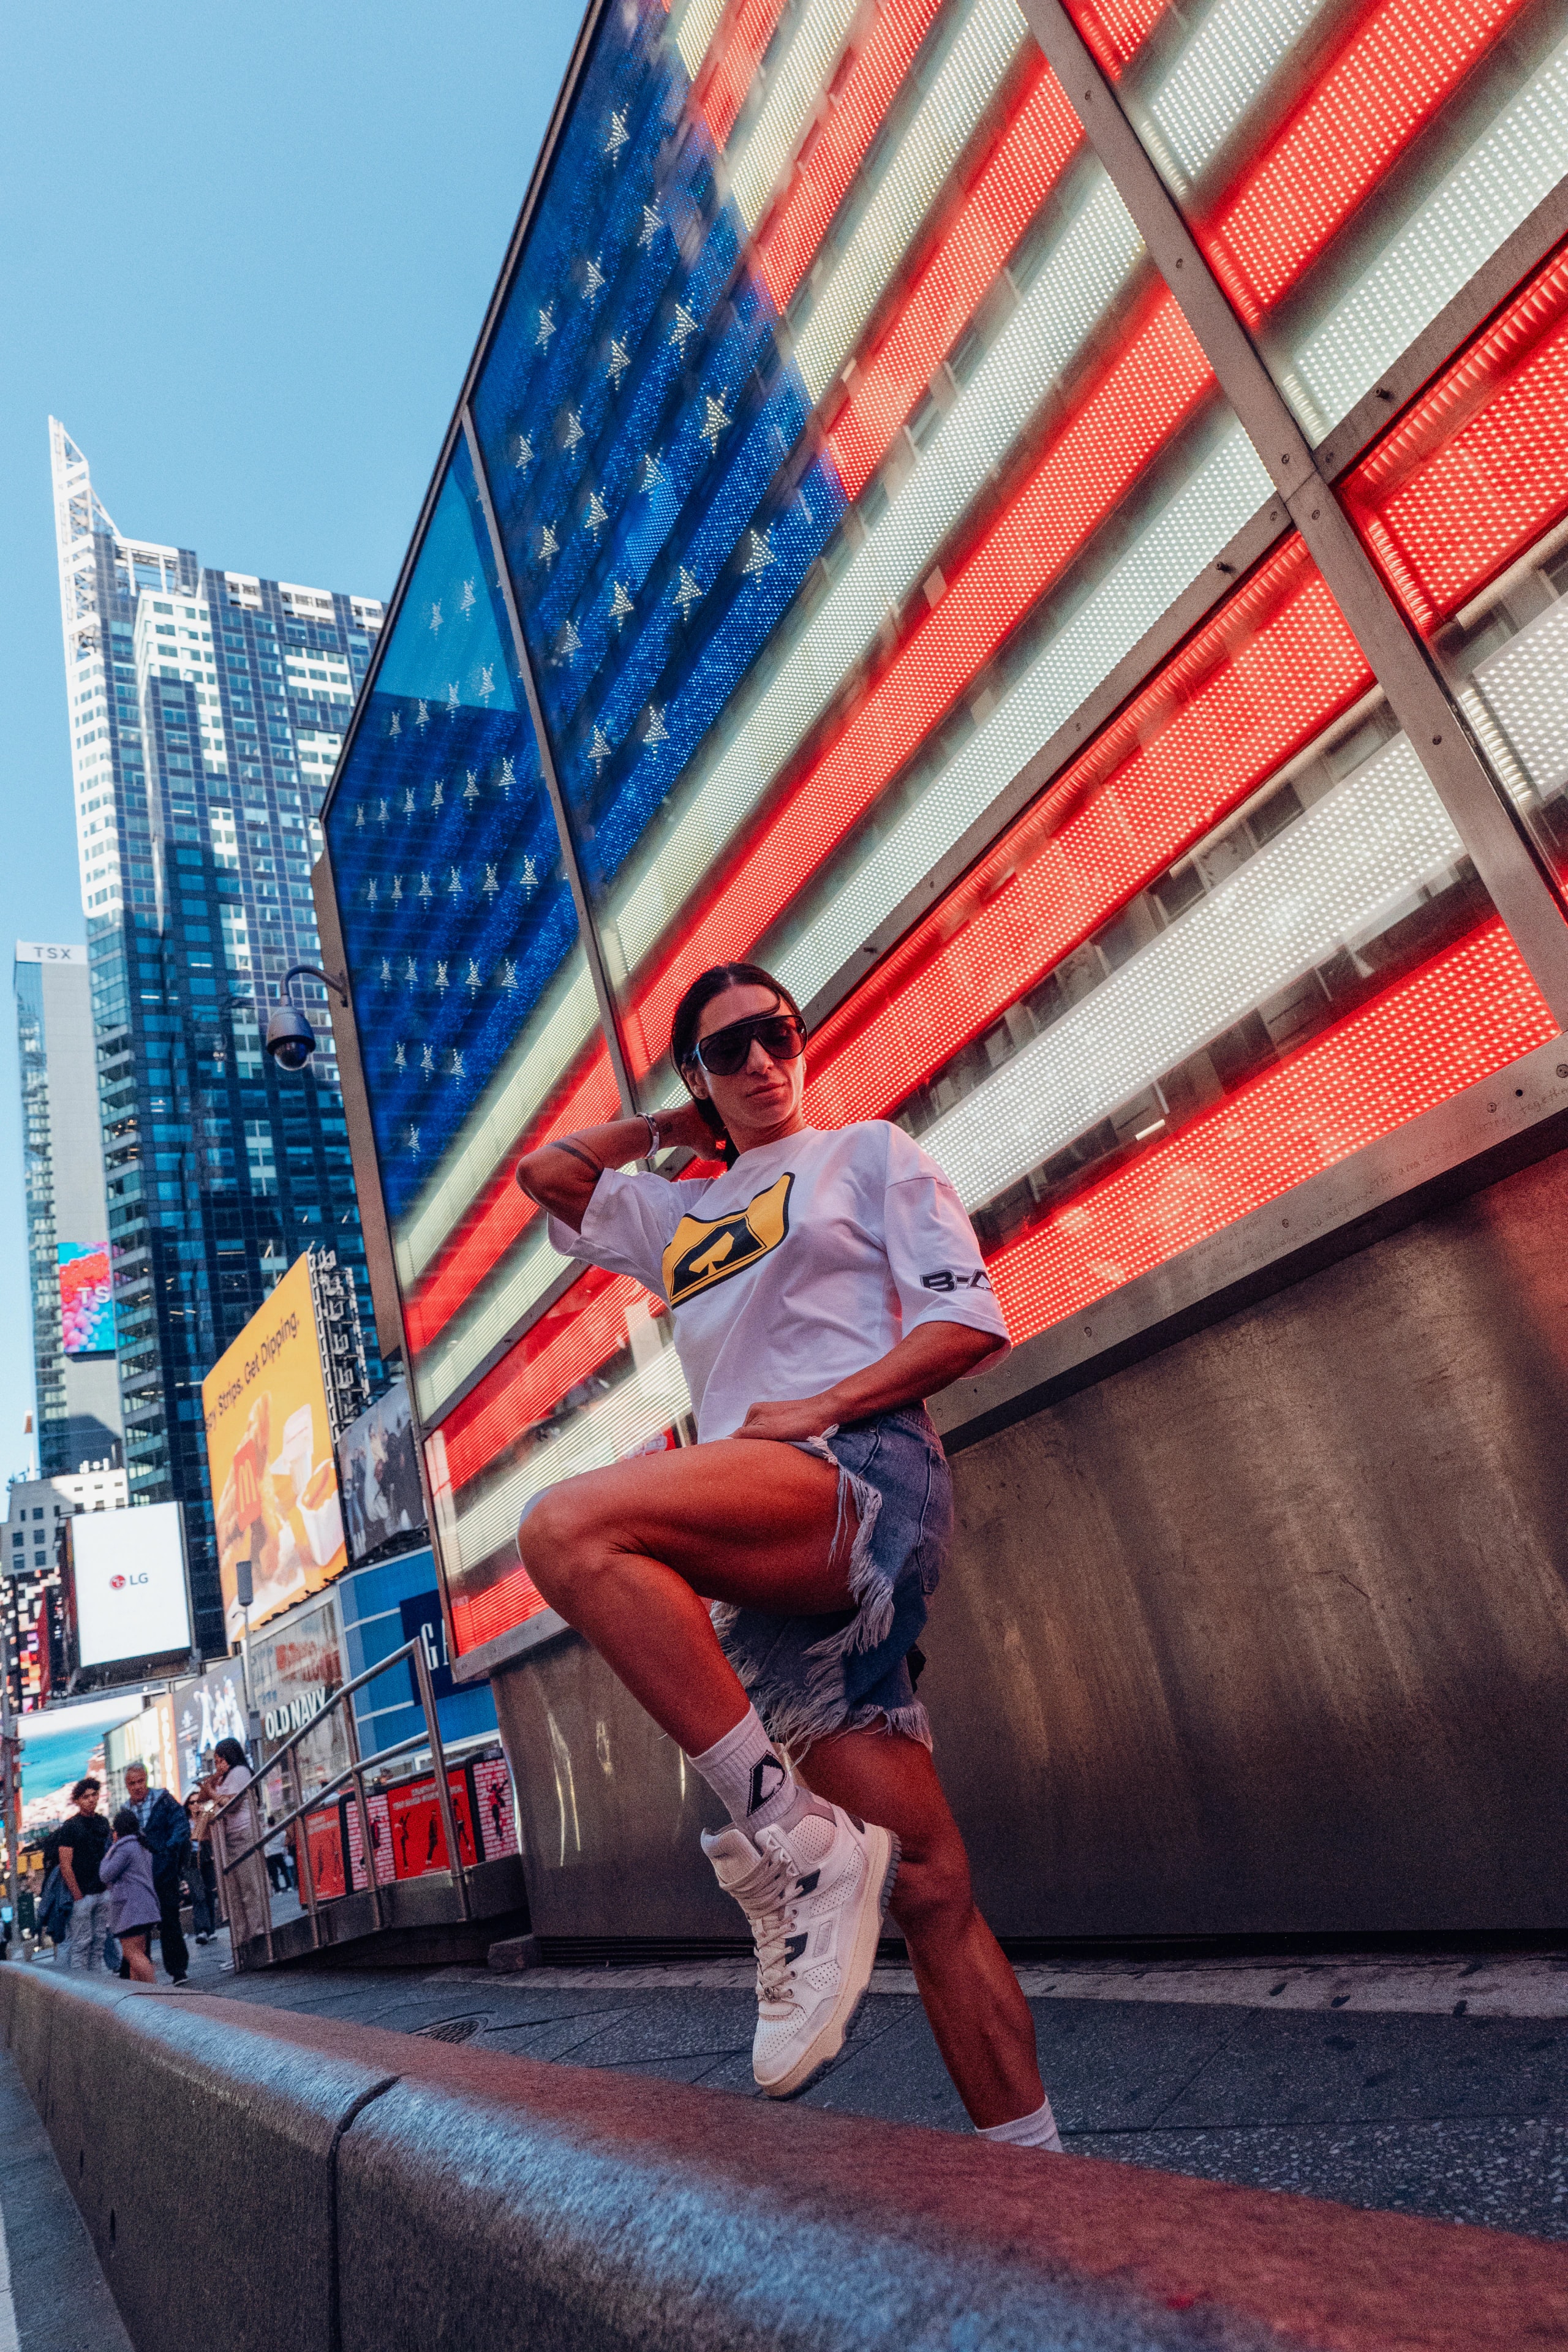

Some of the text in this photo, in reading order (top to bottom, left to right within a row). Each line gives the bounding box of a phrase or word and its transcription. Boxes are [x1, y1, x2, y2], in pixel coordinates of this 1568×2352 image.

[33, 946, 71, 960] TSX
[76, 1286, 110, 1304] TS
[244, 1352, 260, 1385] Get
[130, 1572, 148, 1585] LG
[265, 1686, 326, 1741] OLD NAVY
